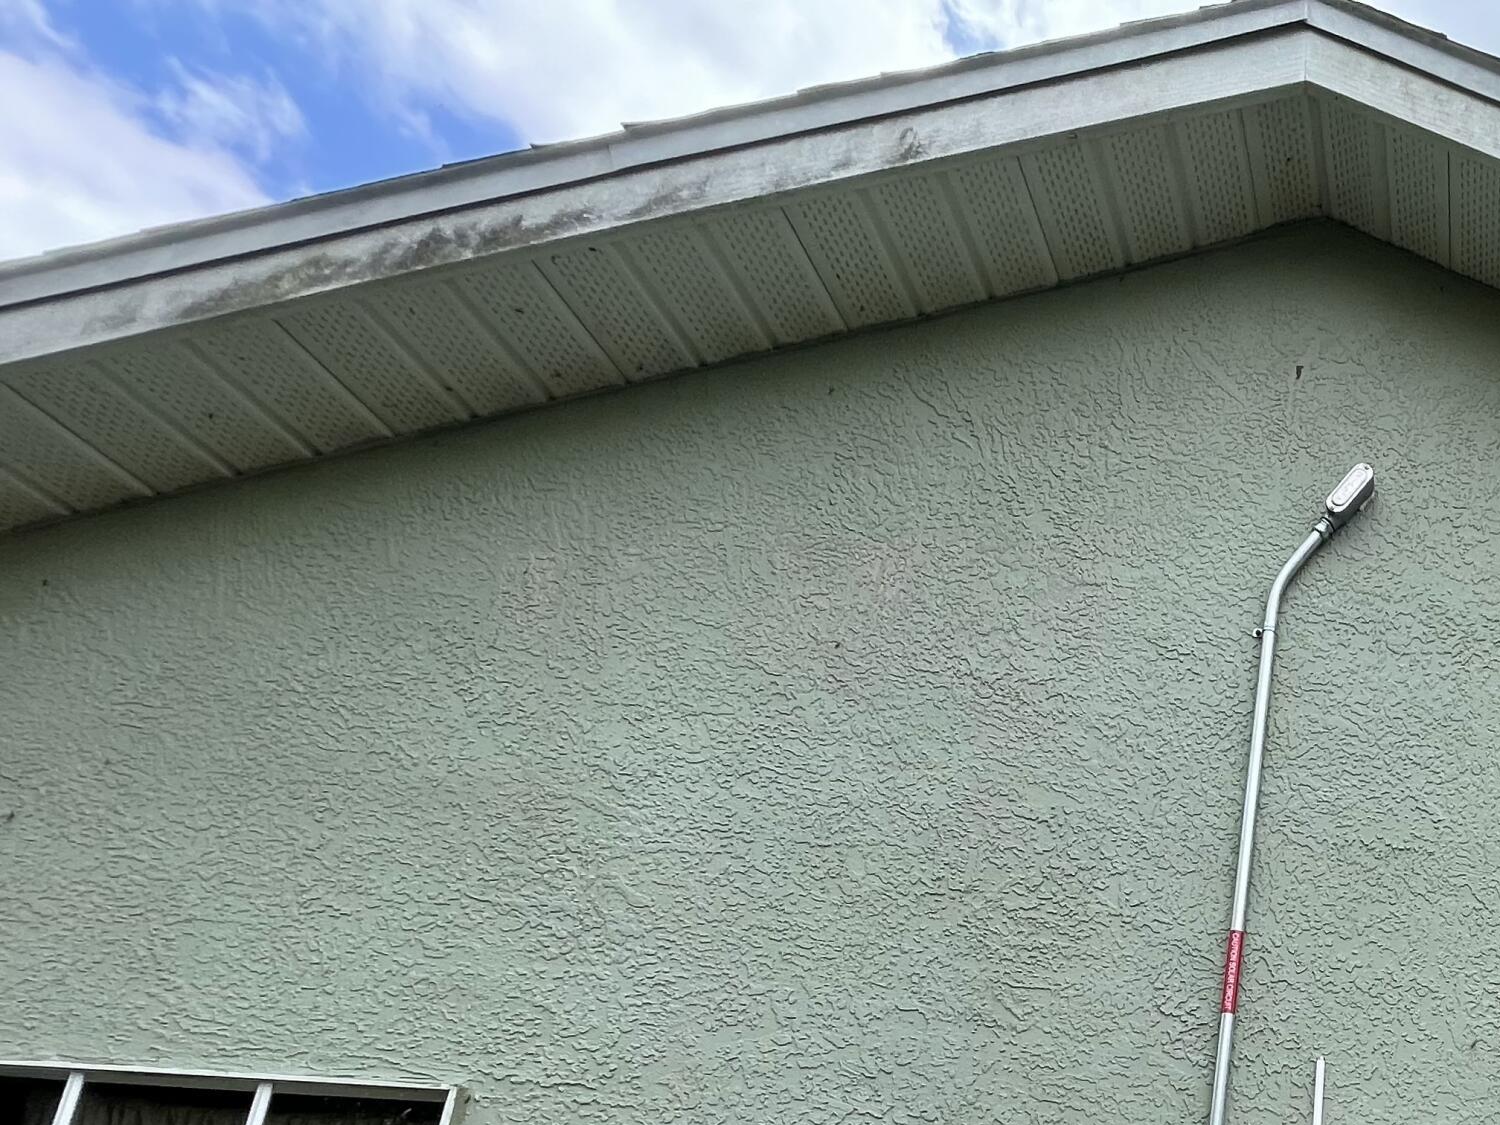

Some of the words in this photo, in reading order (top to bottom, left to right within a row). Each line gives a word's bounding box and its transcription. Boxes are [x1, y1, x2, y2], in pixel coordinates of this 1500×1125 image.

[1230, 932, 1240, 961] CAUTION
[1228, 962, 1238, 983] SOLAR
[1224, 984, 1234, 1010] CIRCUIT
